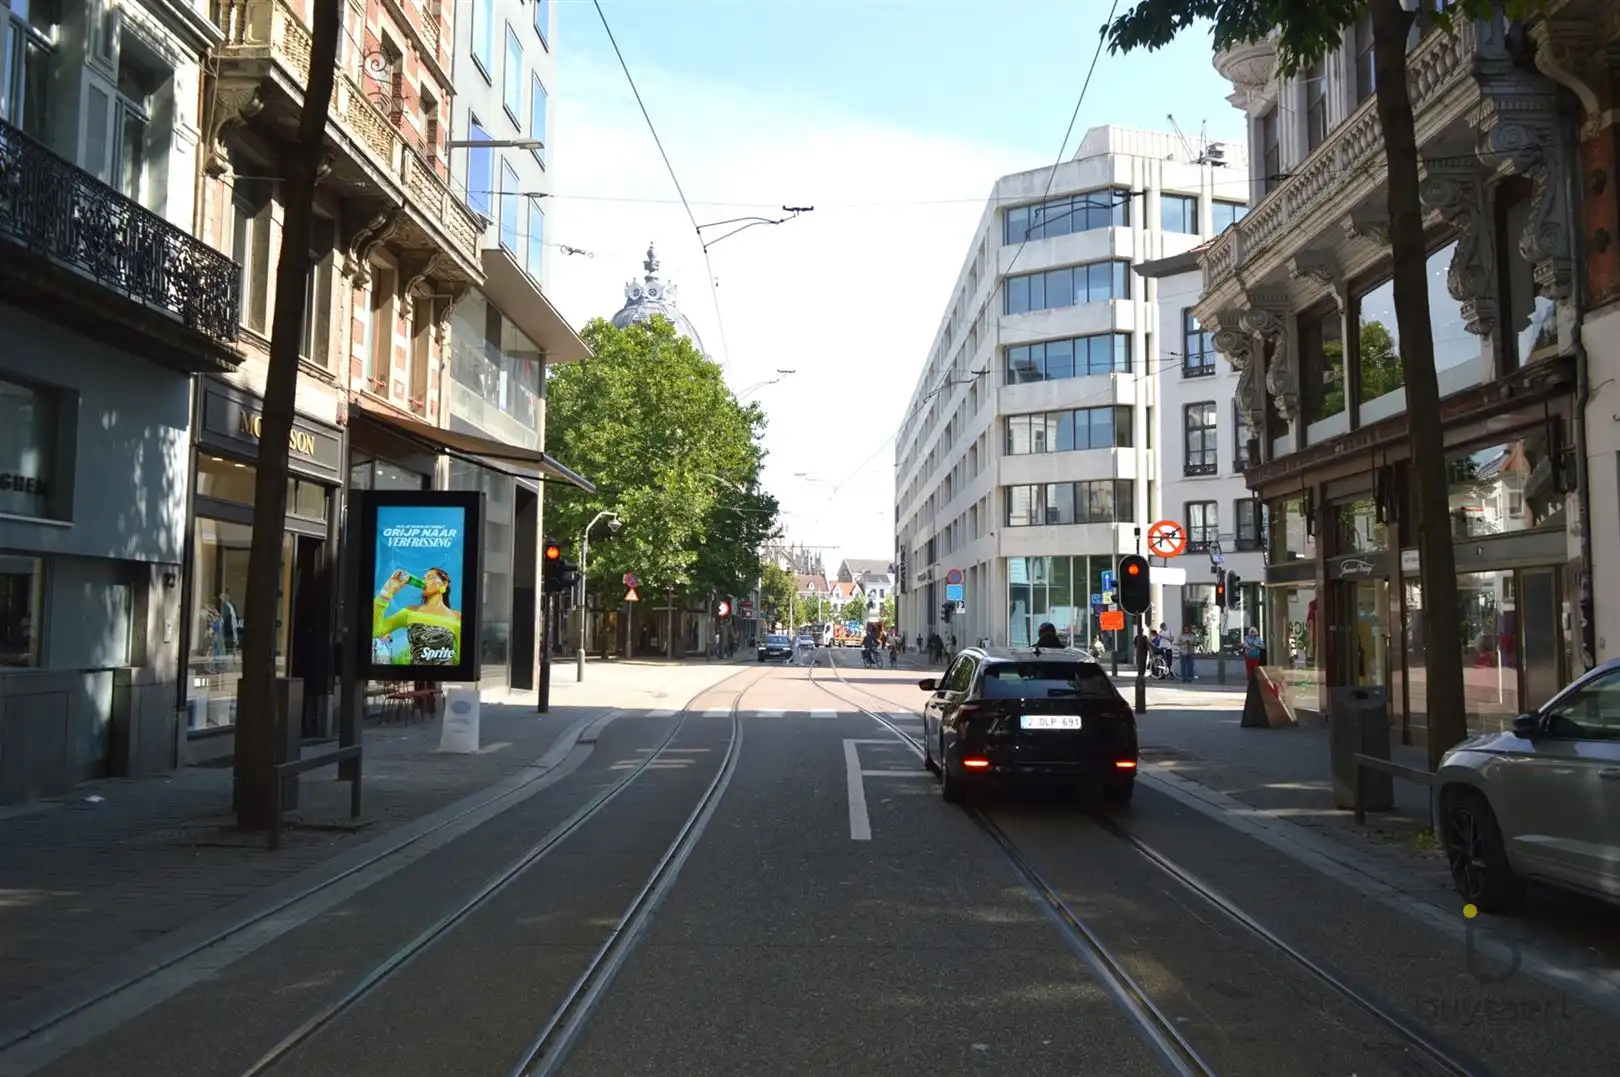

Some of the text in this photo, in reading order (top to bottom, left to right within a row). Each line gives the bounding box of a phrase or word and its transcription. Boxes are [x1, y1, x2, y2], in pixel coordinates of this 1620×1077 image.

[240, 410, 315, 456] MOSON
[383, 528, 457, 537] GRIJP NAAR
[421, 647, 455, 660] Sprite
